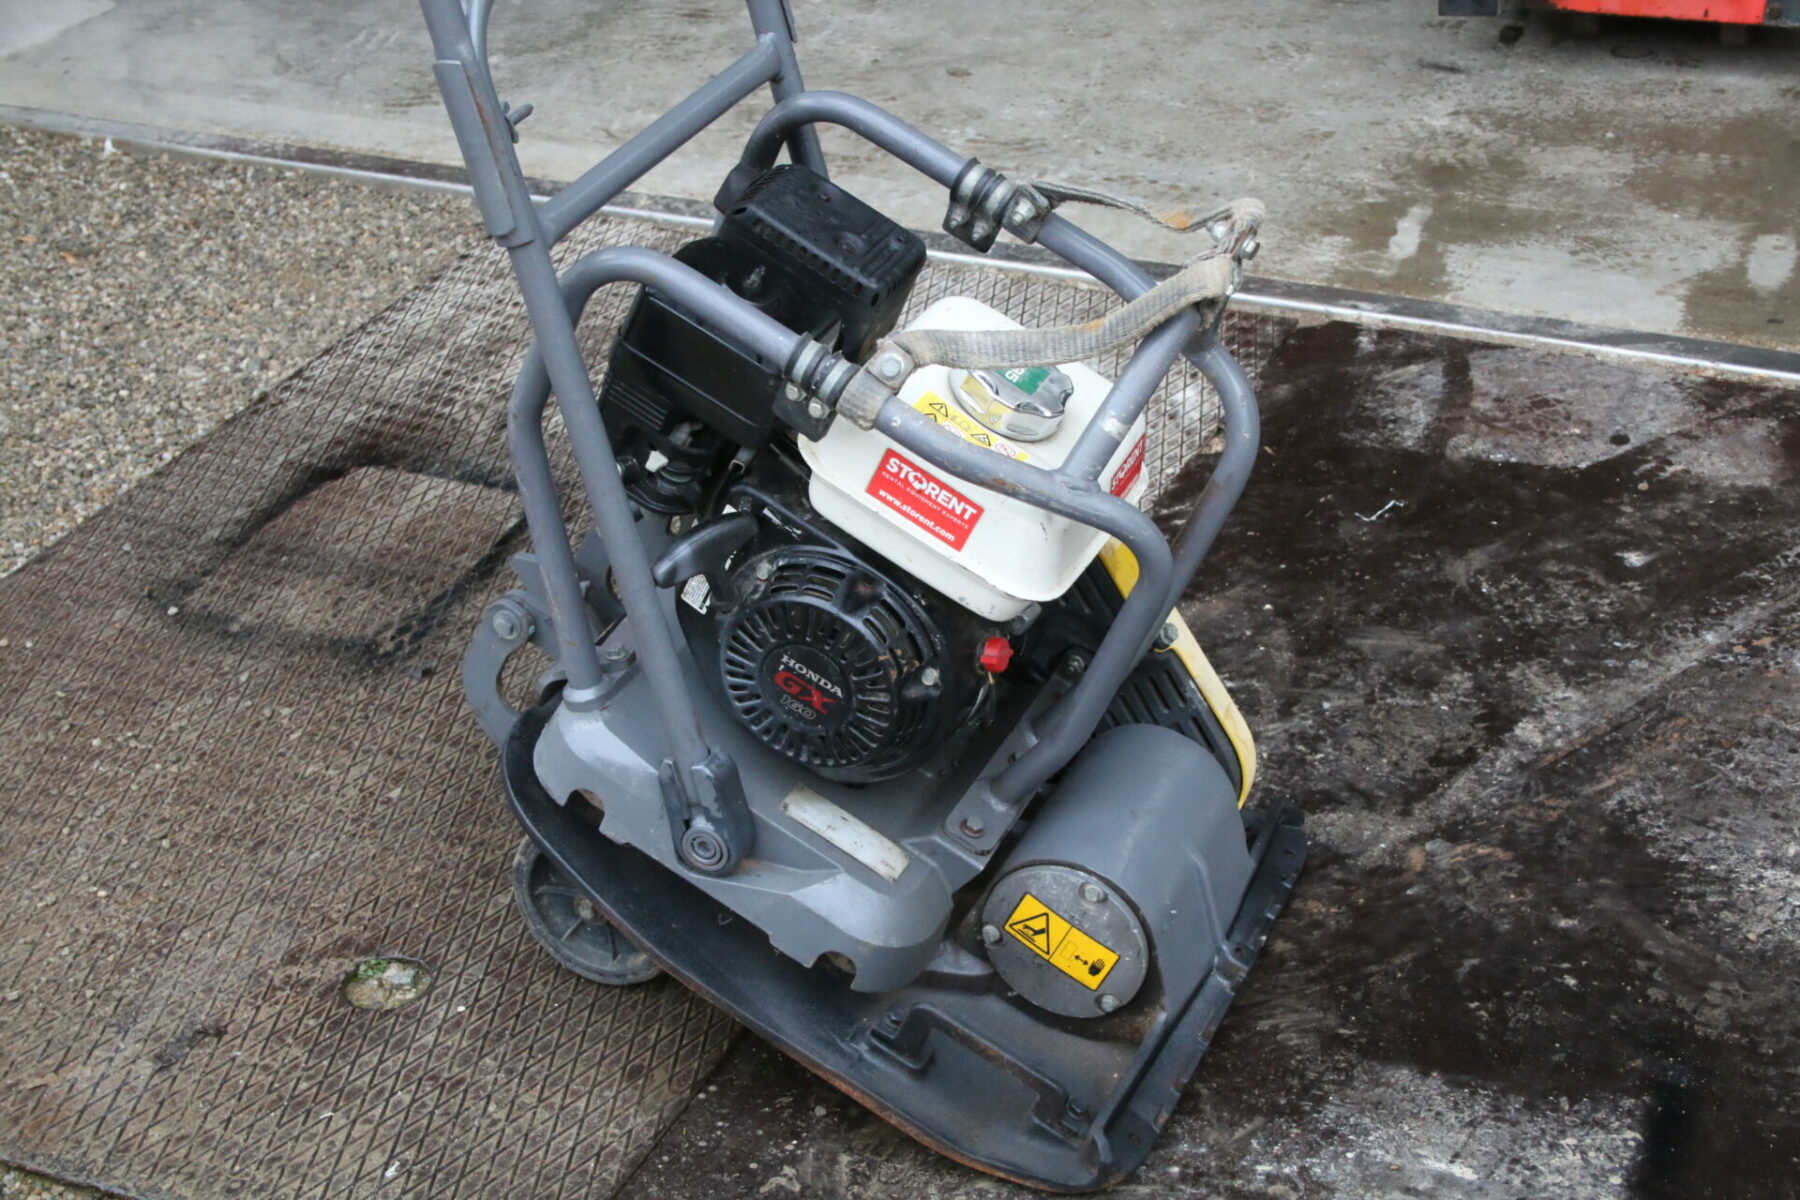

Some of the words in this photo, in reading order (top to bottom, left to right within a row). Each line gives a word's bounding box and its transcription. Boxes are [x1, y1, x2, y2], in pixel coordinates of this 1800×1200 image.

[880, 471, 905, 489] RENTAL
[906, 487, 942, 512] EQUIPMENT
[942, 510, 969, 530] EXPERTS
[885, 456, 977, 521] STORENT
[879, 489, 956, 542] www.storent.com
[774, 671, 836, 715] GX
[780, 654, 844, 699] HONDA
[780, 694, 817, 720] 160
